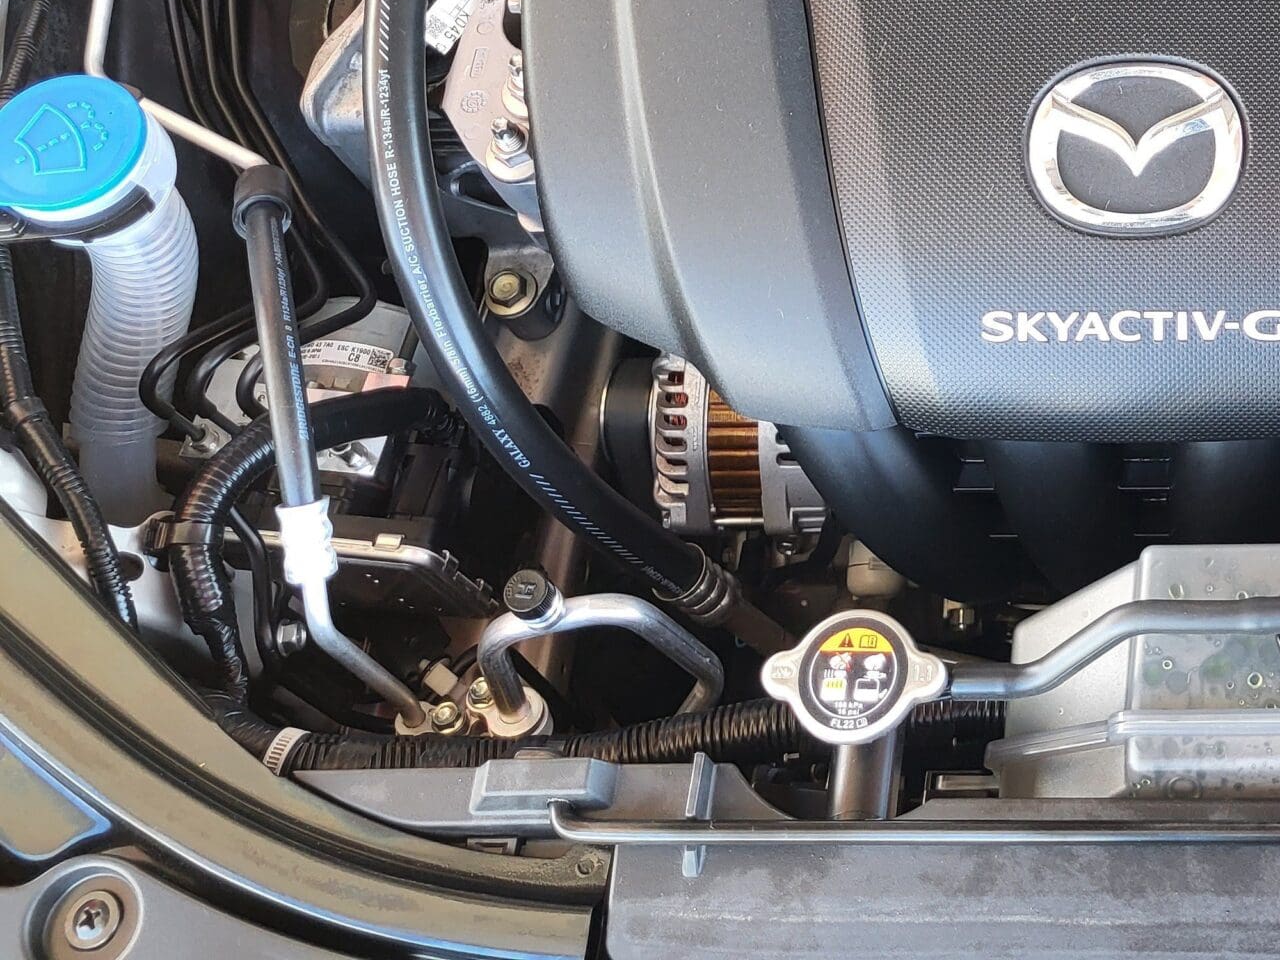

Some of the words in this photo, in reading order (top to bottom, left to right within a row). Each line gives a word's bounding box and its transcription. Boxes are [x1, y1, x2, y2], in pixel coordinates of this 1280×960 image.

[443, 9, 472, 44] KD45
[377, 68, 396, 159] R-134a/R-1234yf
[386, 162, 402, 198] HOSE
[392, 199, 416, 252] SUCTION
[409, 253, 425, 276] A/C
[416, 276, 449, 341] Flexbarrier
[286, 335, 298, 359] E-CR
[289, 363, 309, 440] BRIDGESTONE
[477, 404, 499, 427] 4882
[491, 425, 532, 469] GALAXY
[830, 716, 855, 729] FL22
